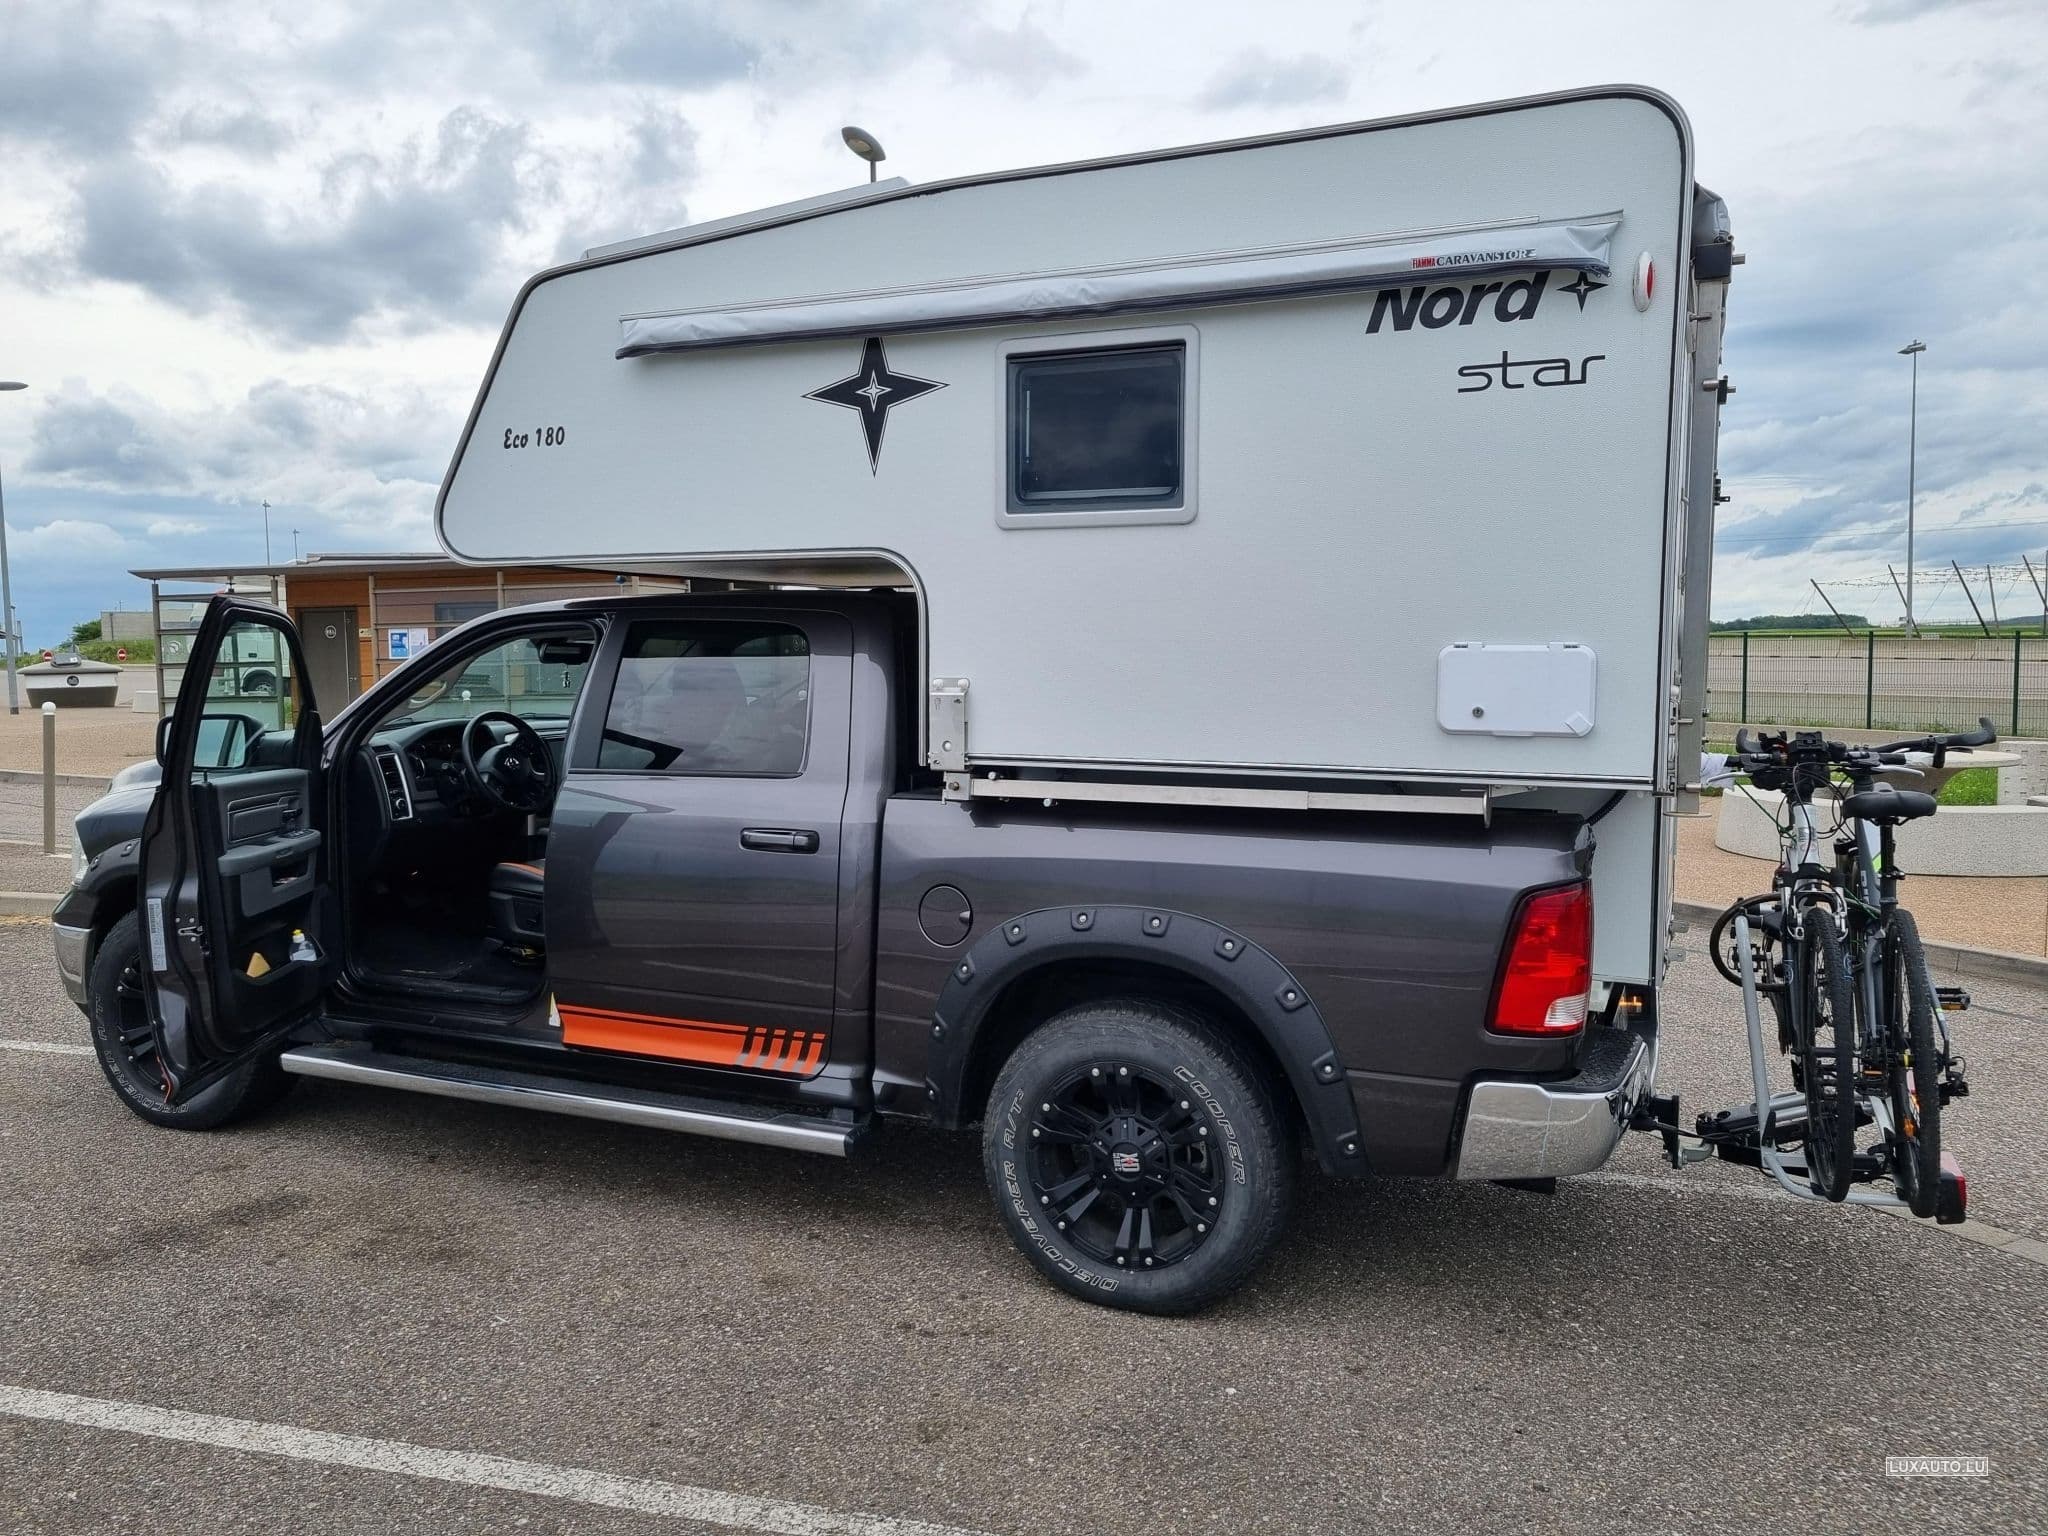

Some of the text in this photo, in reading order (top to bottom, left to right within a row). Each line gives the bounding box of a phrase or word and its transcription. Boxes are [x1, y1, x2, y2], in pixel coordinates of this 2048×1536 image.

[1412, 257, 1436, 269] FIAMMA
[1365, 270, 1551, 334] Nord
[1458, 351, 1605, 393] star
[503, 426, 565, 449] Eco 180
[1173, 1066, 1246, 1184] COOPER
[1003, 1161, 1120, 1292] DISCOVERER
